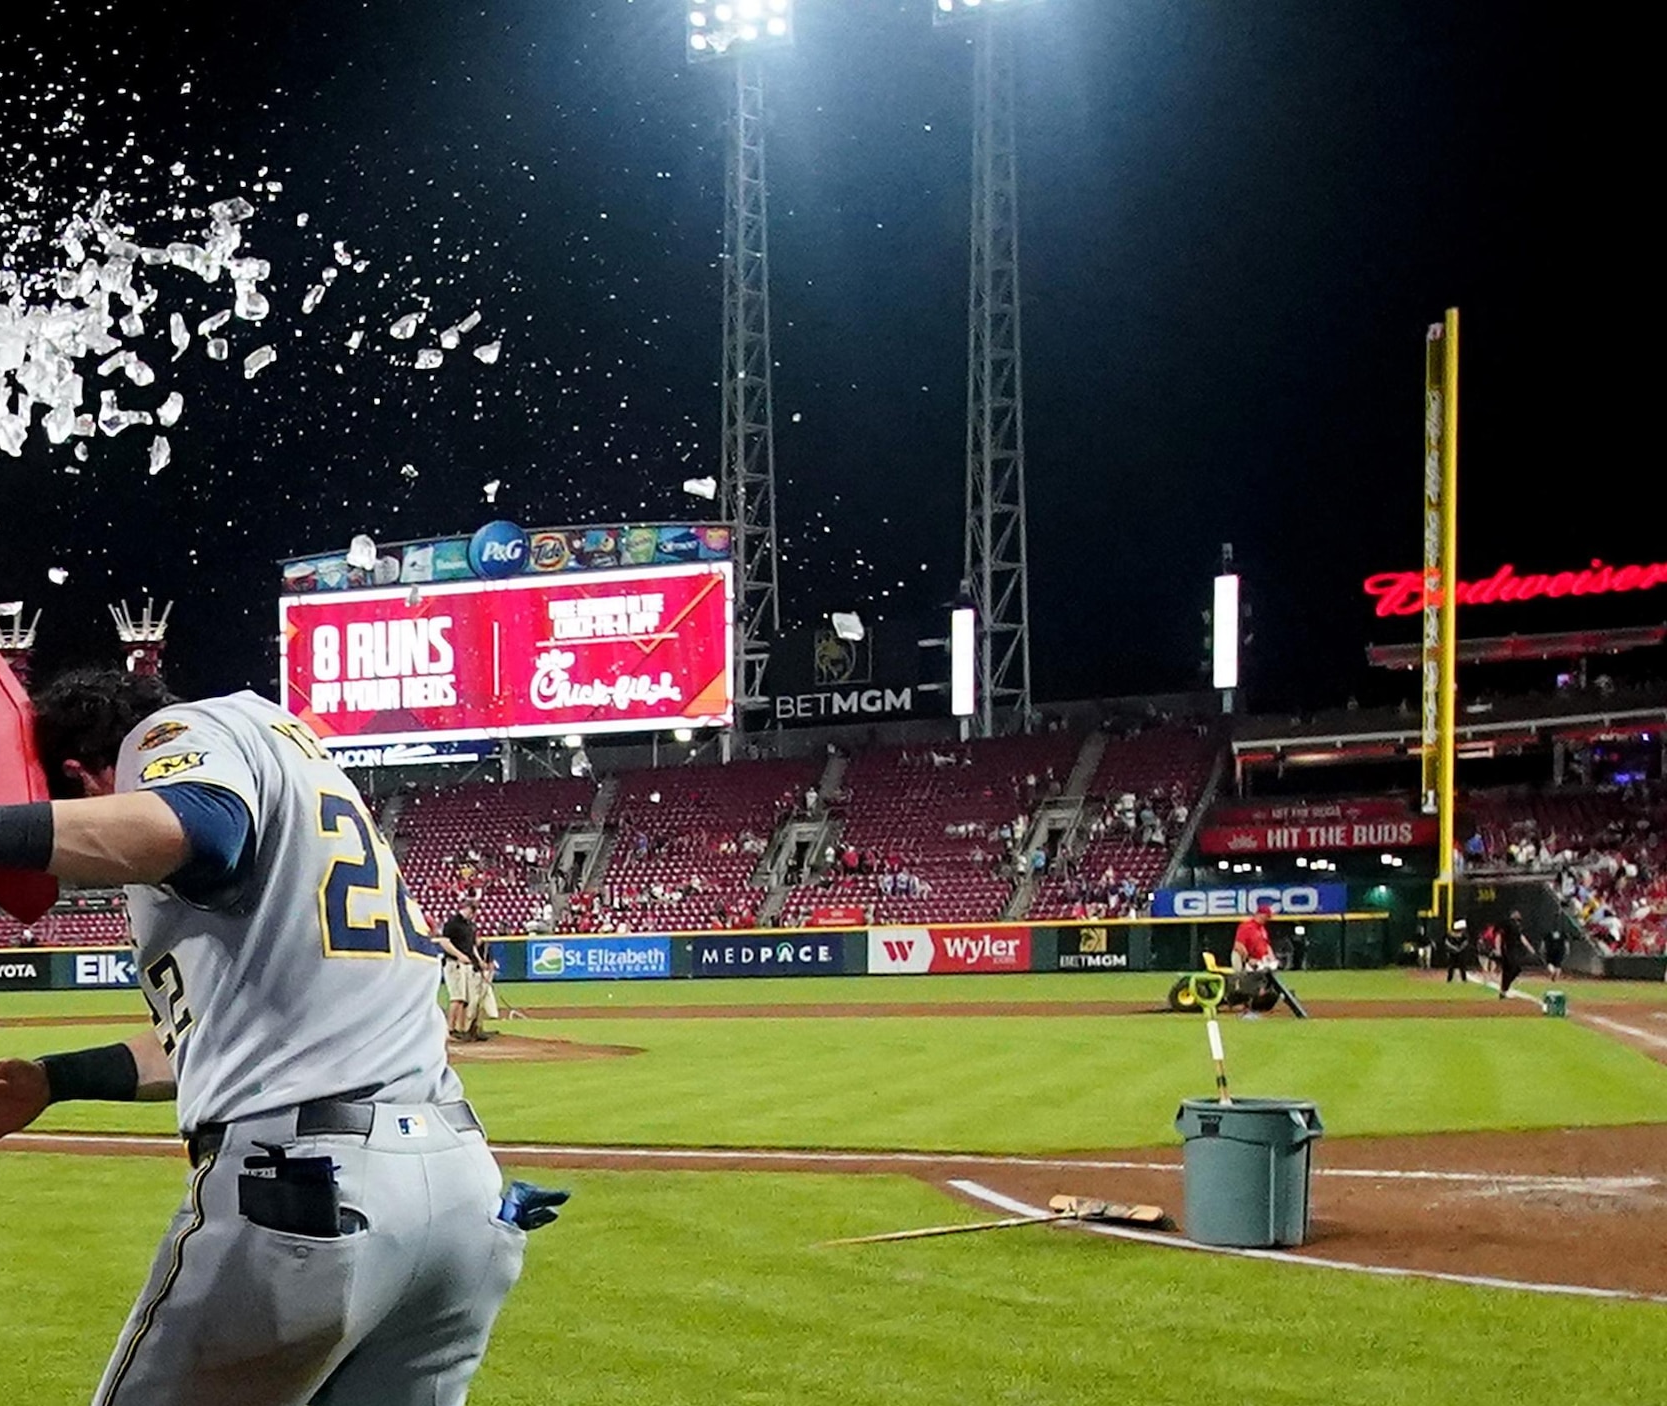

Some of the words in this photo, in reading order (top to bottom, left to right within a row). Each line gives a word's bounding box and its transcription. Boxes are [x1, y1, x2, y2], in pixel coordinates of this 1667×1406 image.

[482, 540, 523, 562] P&G
[313, 625, 340, 681] 8
[346, 616, 454, 679] RUNS
[776, 688, 912, 718] BETMGM
[1267, 828, 1300, 849] HIT
[1307, 825, 1348, 847] THE
[1353, 823, 1413, 845] BUDS
[1174, 887, 1319, 916] GEICO
[588, 947, 665, 965] Elizabeth
[942, 934, 1020, 964] Wyler
[1060, 954, 1127, 968] BETMGM
